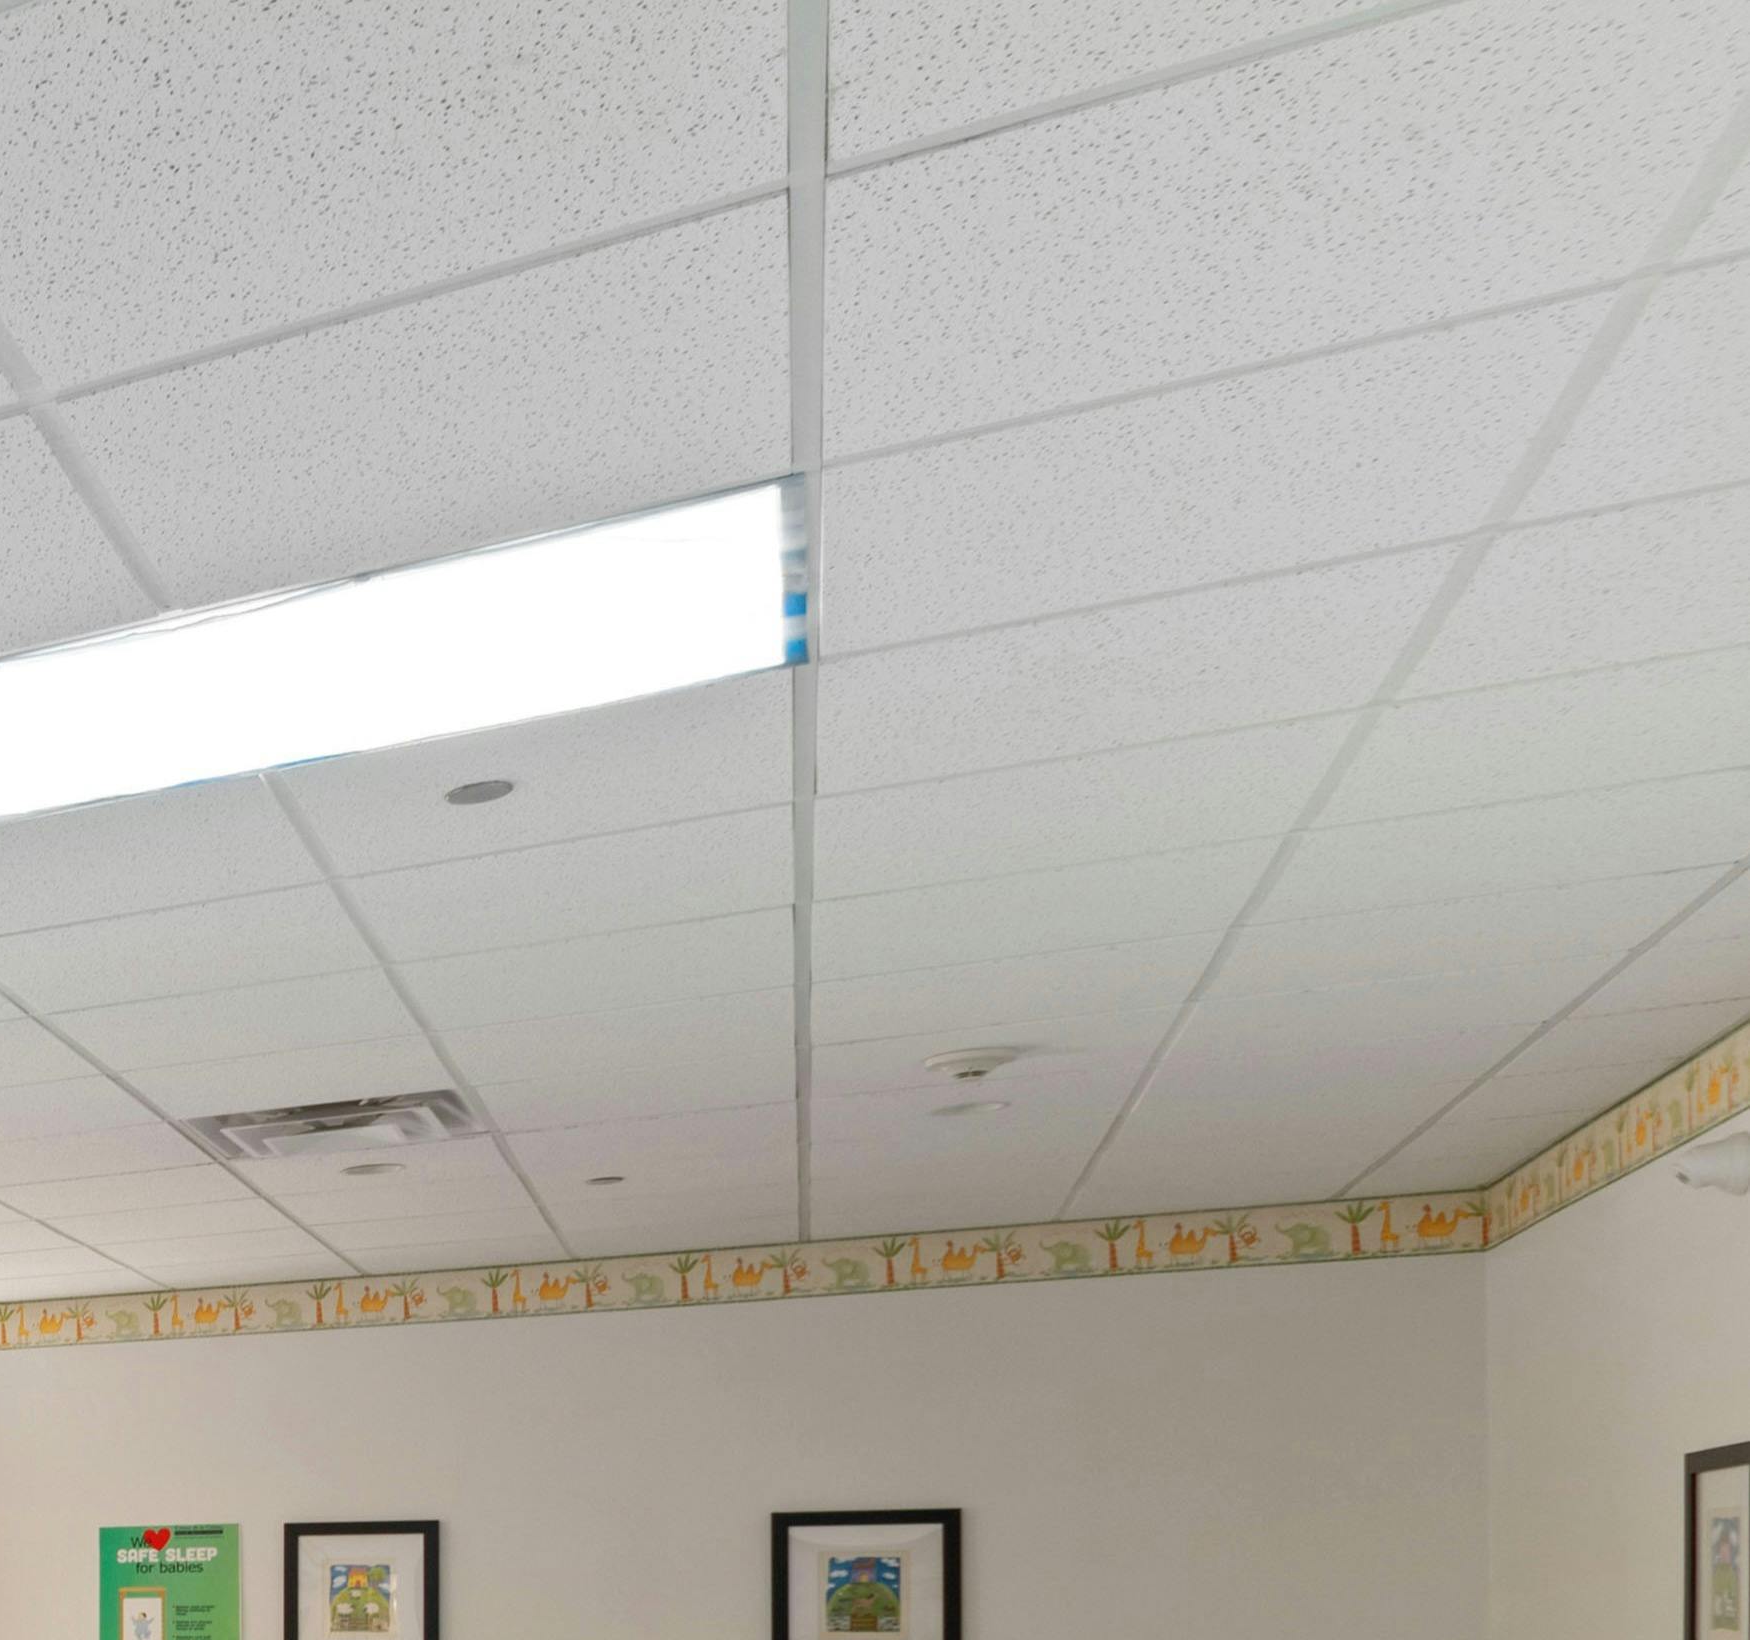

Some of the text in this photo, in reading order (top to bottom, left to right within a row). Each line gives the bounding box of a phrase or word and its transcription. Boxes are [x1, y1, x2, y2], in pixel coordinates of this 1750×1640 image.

[116, 1547, 218, 1563] SAFE SLEEP
[136, 1562, 204, 1574] for babies
